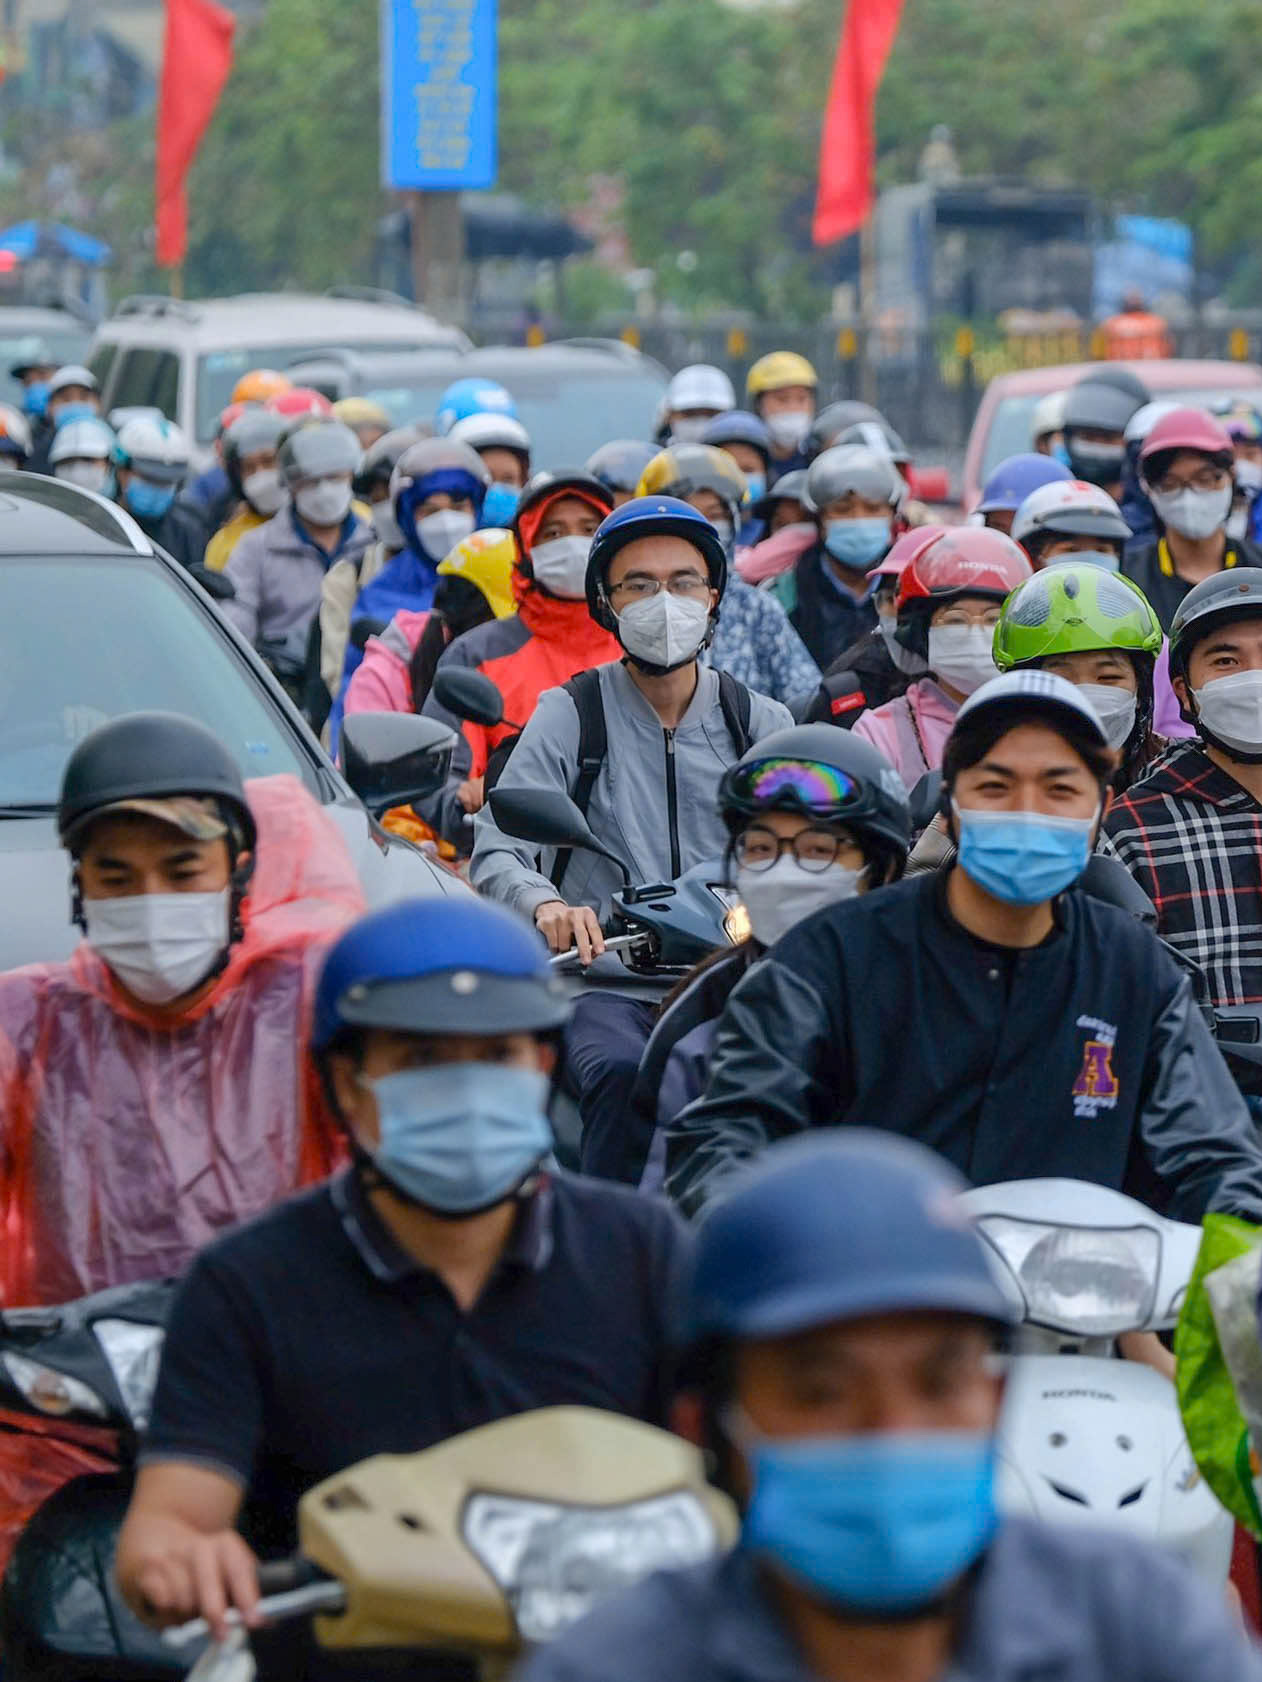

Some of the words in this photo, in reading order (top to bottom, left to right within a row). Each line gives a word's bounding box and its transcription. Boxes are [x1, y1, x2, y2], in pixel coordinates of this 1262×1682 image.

[957, 561, 1008, 576] HONDA
[1072, 1040, 1119, 1097] A
[1041, 1388, 1119, 1402] HONDA
